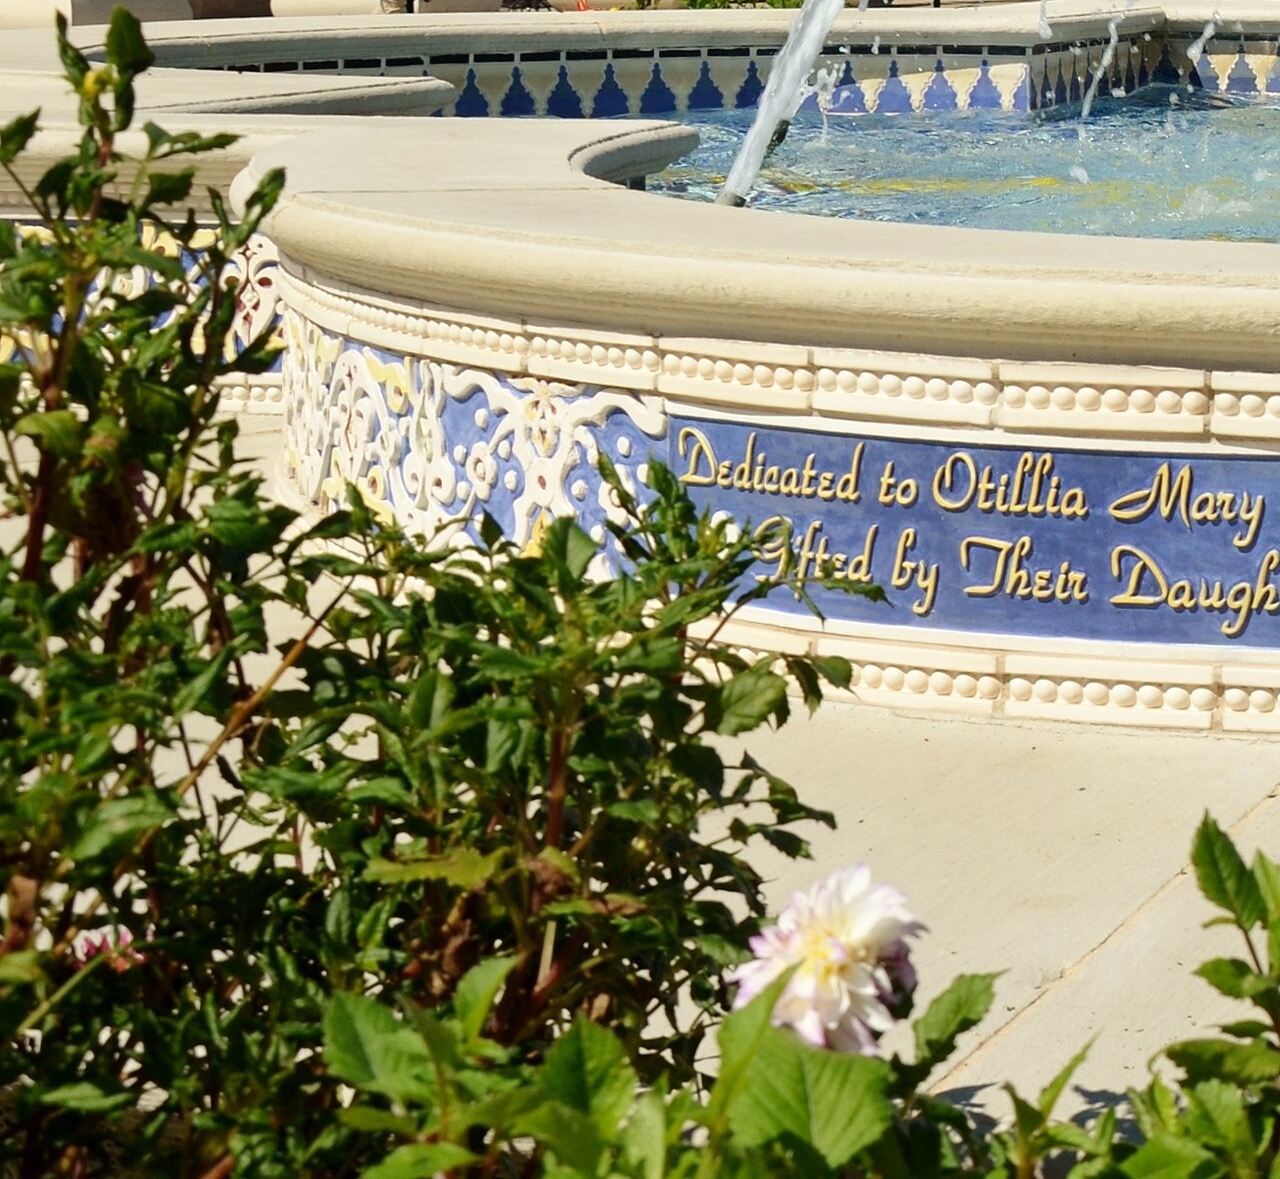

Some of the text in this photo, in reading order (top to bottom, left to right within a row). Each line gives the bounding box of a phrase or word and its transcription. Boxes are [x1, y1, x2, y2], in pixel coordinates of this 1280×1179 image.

[679, 426, 865, 503] Dedicated
[879, 461, 918, 506] to
[932, 451, 1089, 517] Otillia
[1108, 462, 1264, 548] Mary
[892, 528, 938, 616] by
[960, 536, 1089, 601] Their
